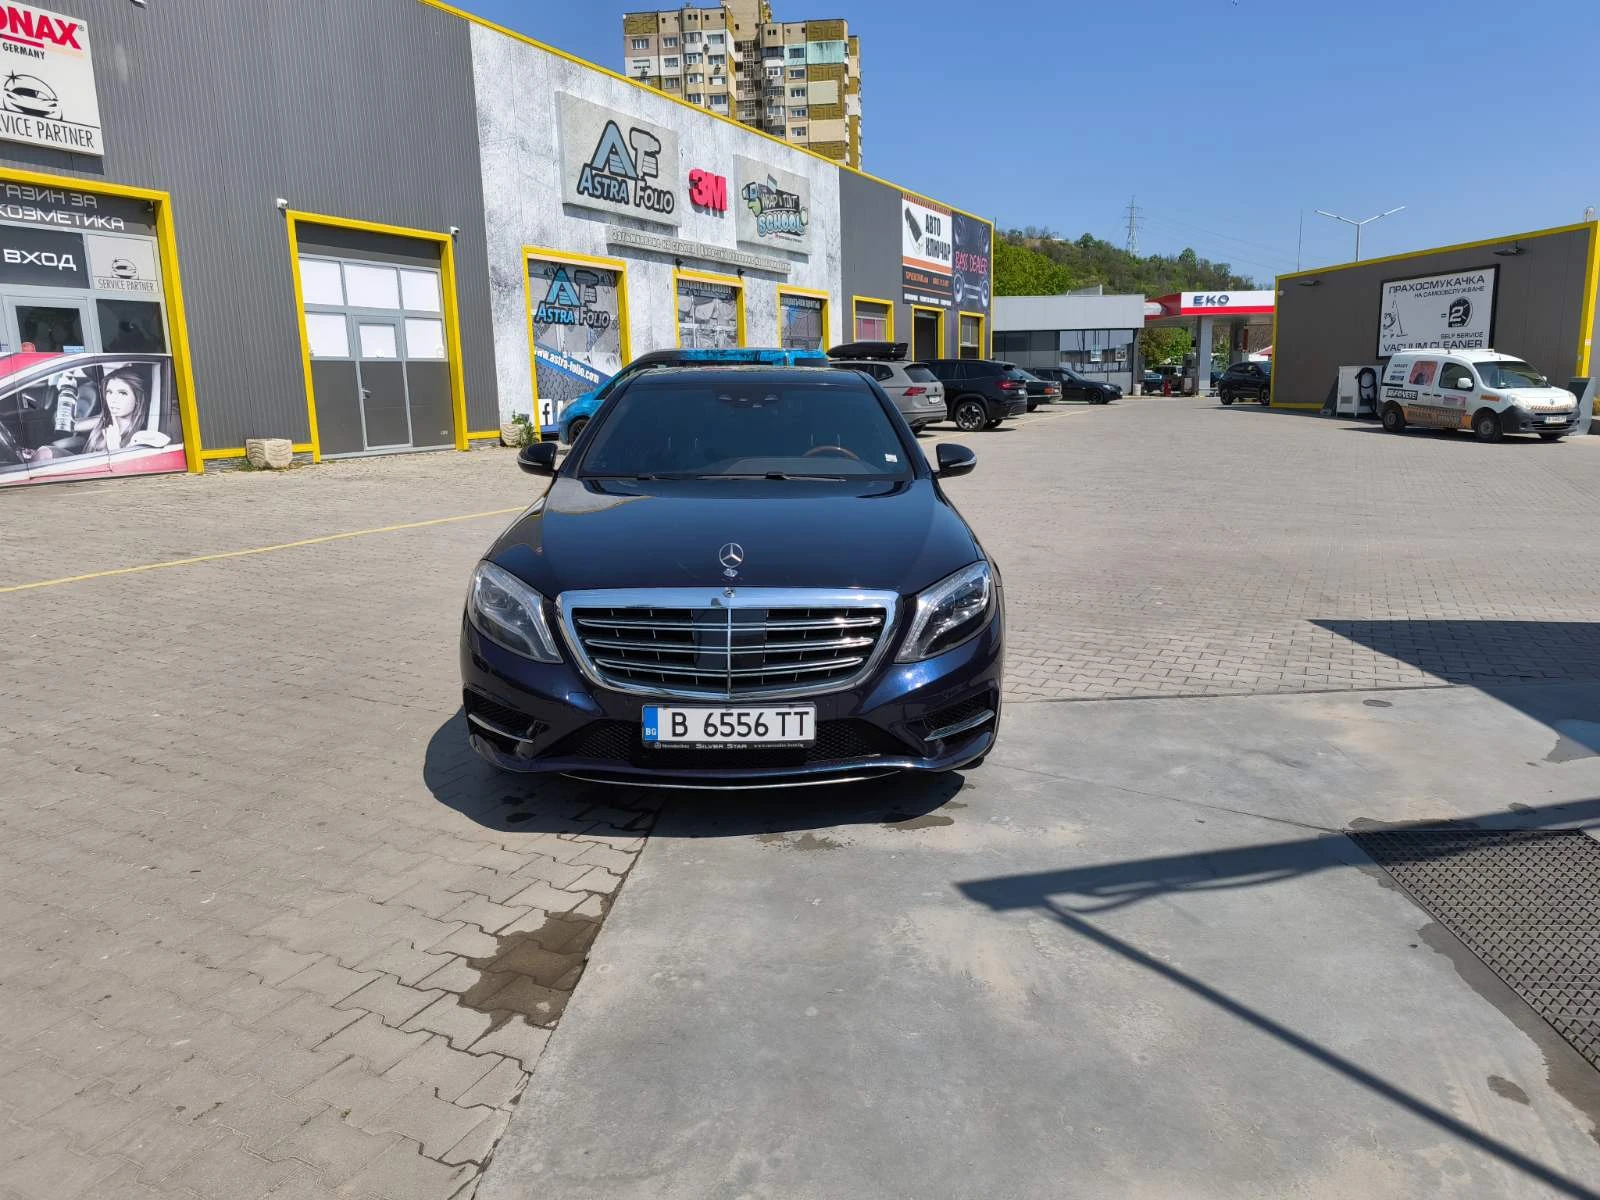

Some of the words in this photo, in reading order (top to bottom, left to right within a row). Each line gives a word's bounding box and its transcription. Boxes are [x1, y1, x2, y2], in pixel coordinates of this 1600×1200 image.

[2, 41, 46, 60] GERMANY
[0, 113, 33, 138] VICE
[36, 120, 95, 149] PARTNER
[576, 163, 630, 205] ASTRA
[633, 178, 675, 214] FOLIO
[688, 168, 727, 212] 3M
[69, 192, 98, 209] ЗА
[757, 210, 805, 238] SCHOOL
[925, 213, 941, 237] АВТО
[925, 237, 951, 262] КЛЮЧАР
[3, 249, 77, 272] ВХОД
[97, 278, 126, 291] SERVICE
[126, 280, 155, 293] PARTNER
[1388, 274, 1486, 295] ПРАХОСМУКАЧКА
[1423, 285, 1485, 298] САМООБСЛУЖВАНЕ
[1192, 294, 1230, 306] EKO
[534, 301, 576, 326] ASTRA
[579, 305, 611, 329] FOLIO
[1449, 306, 1464, 322] 2
[1456, 331, 1484, 339] SERVICE
[1383, 341, 1428, 353] VACUUM
[1429, 340, 1483, 350] CLEANER
[645, 728, 657, 736] BG
[671, 712, 688, 737] B
[703, 712, 769, 738] 6556
[775, 710, 810, 737] TT
